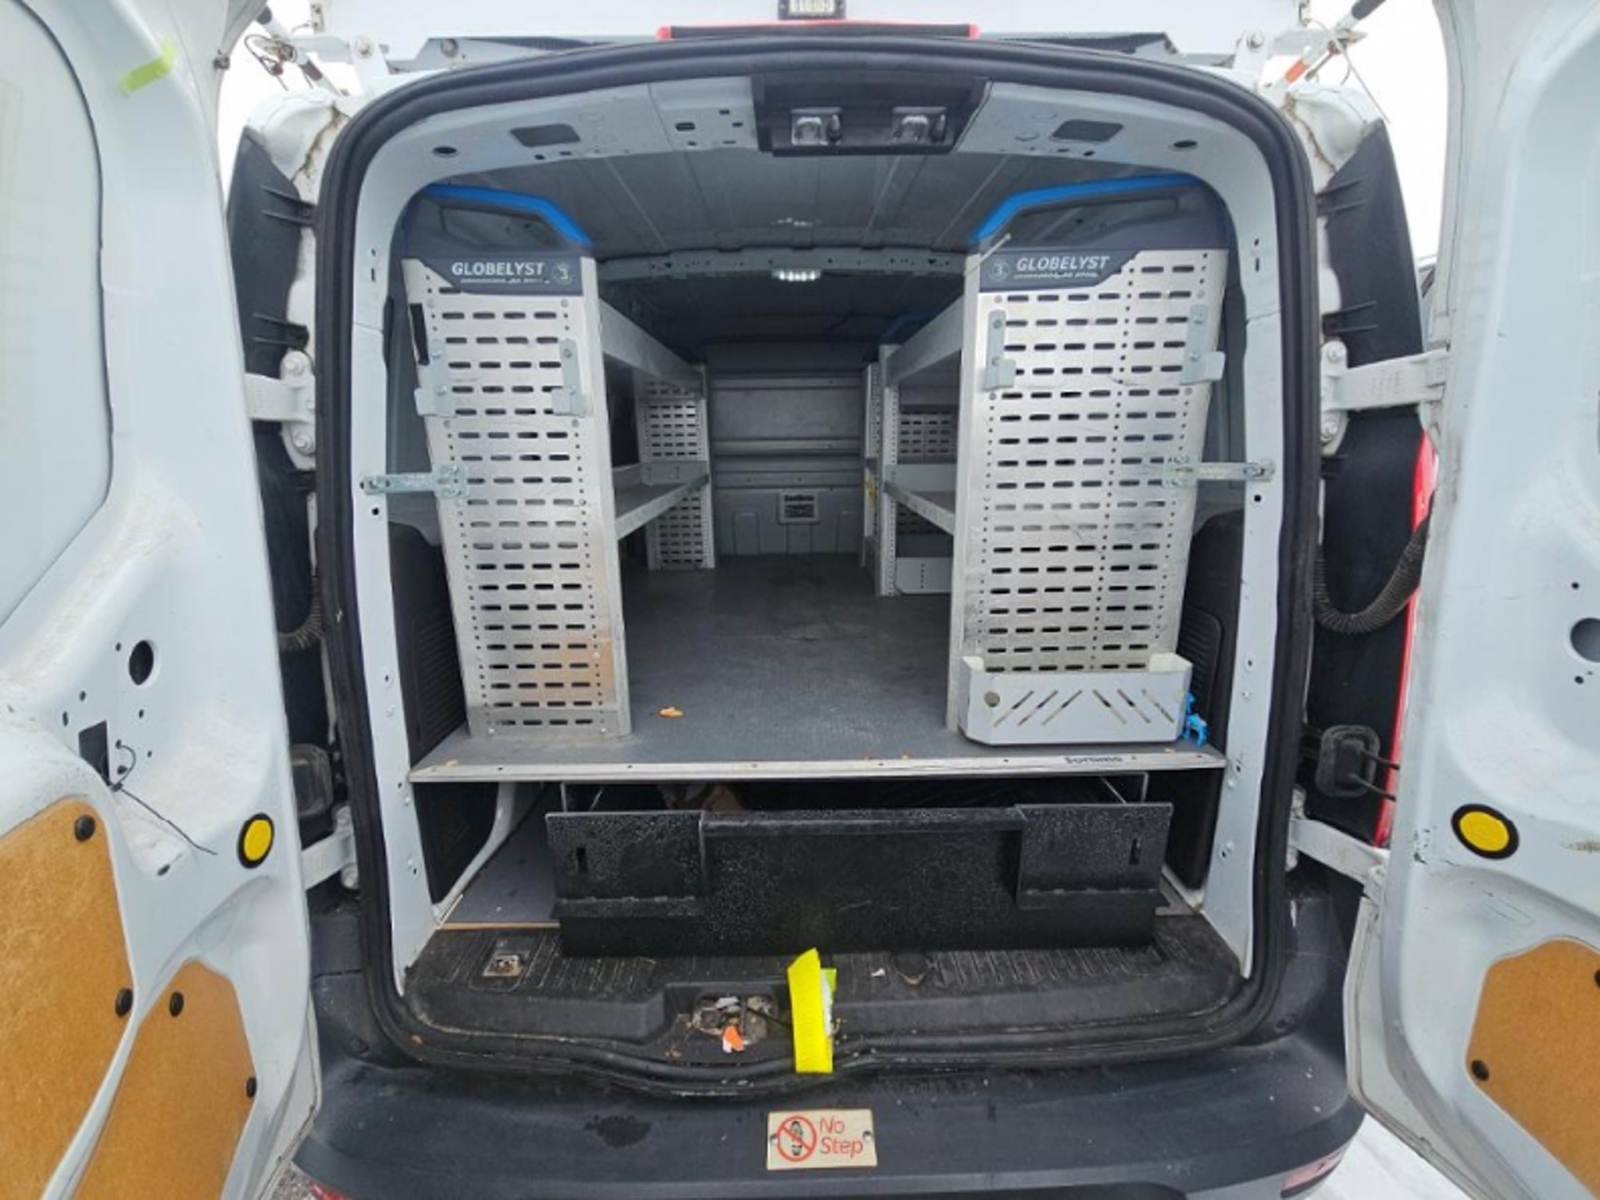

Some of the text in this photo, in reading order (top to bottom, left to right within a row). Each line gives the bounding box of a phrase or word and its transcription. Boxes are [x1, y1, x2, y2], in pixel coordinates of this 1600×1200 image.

[451, 261, 545, 276] GLOBELYST
[1017, 255, 1110, 272] GLOBELYST
[820, 1117, 845, 1134] No
[820, 1136, 863, 1158] Step
